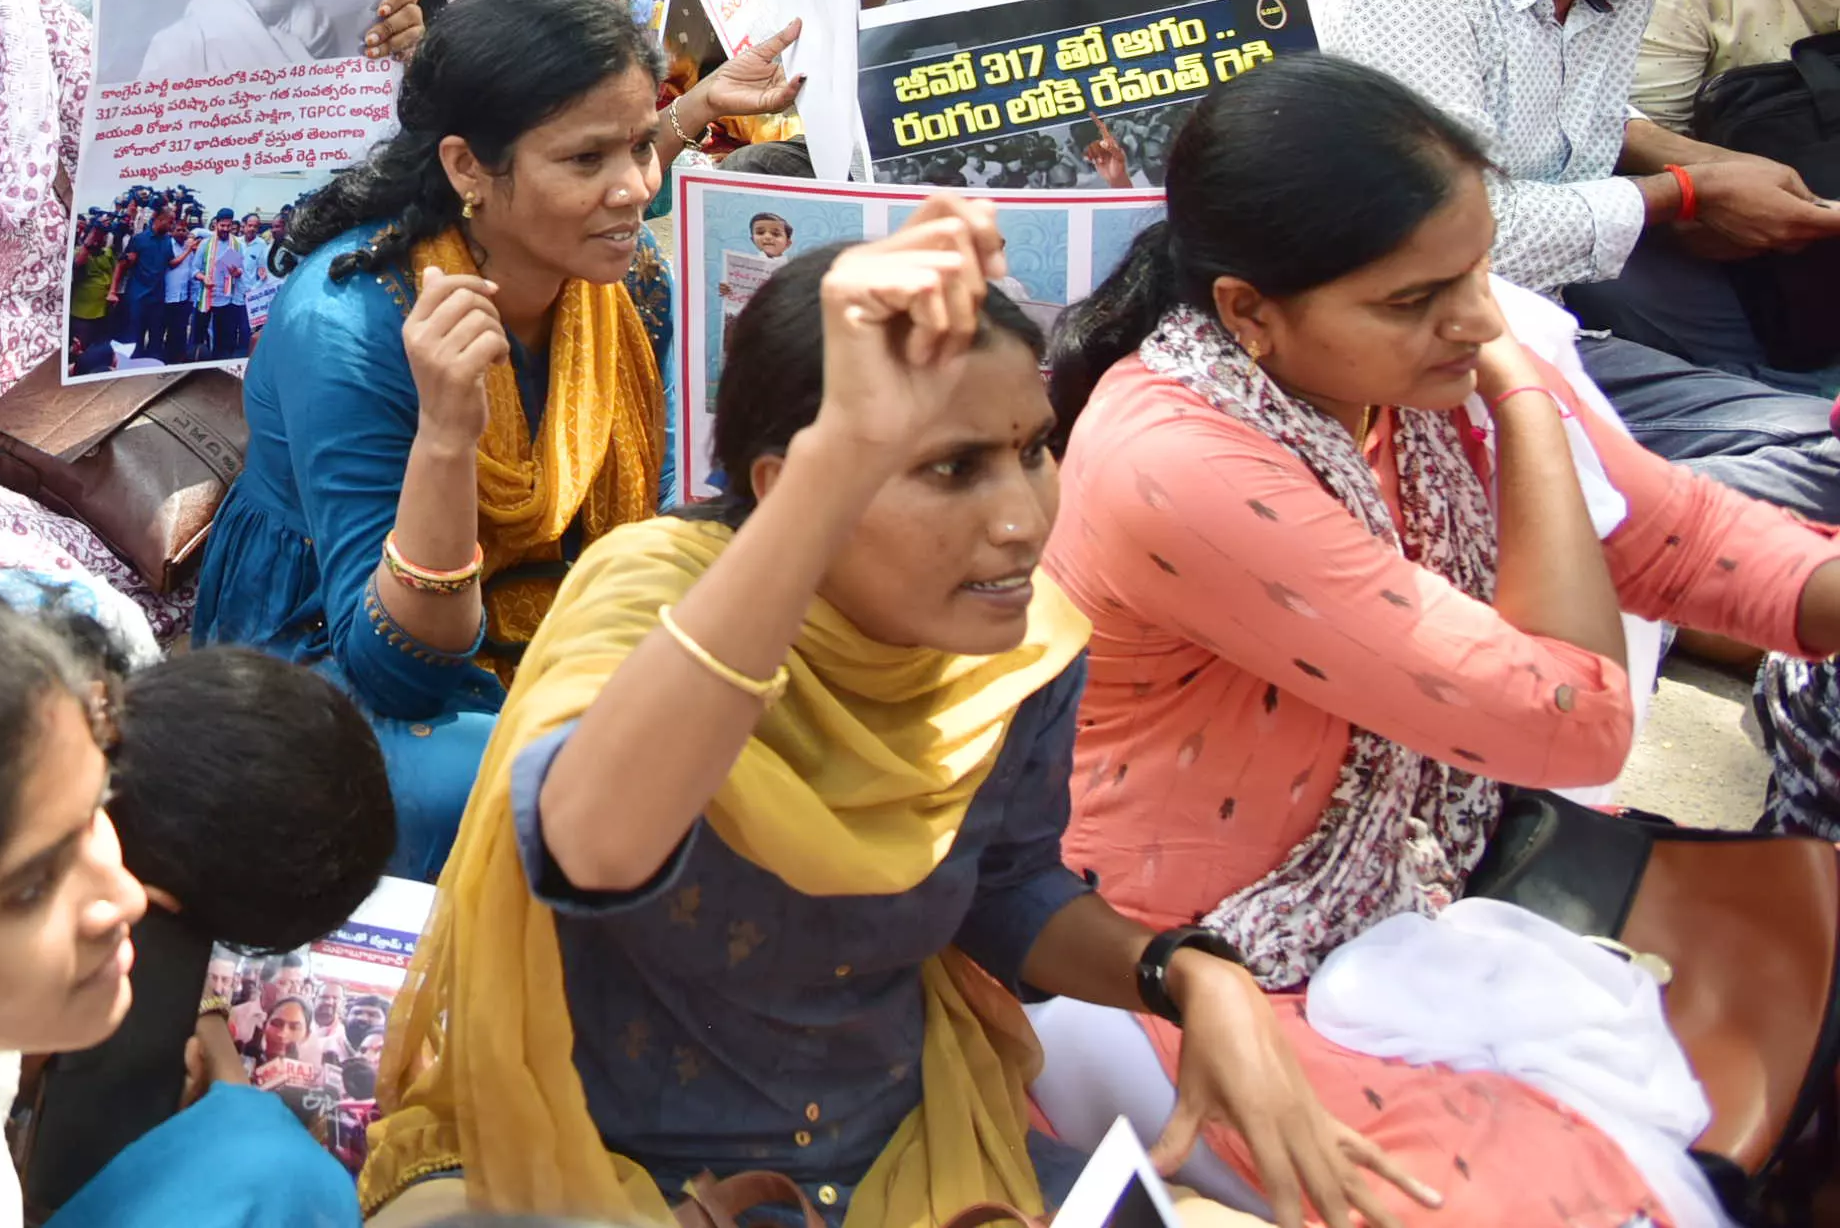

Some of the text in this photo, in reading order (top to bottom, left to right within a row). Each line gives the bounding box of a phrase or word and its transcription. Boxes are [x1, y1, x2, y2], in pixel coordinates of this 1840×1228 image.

[144, 80, 170, 100] పార్టీ
[172, 72, 246, 94] అధికారంలోకి
[250, 68, 287, 86] వచ్చిన
[290, 65, 306, 78] 48
[366, 59, 390, 73] G.O
[892, 15, 1207, 104] జీవో 317 తో ఆగం
[96, 107, 118, 120] 317
[120, 102, 164, 119] సమస్య
[270, 88, 290, 102] గత
[292, 85, 356, 104] సంవత్సరం
[359, 79, 392, 96] గాంధీ
[299, 105, 347, 120] TGPCC
[350, 104, 391, 122] అధ్యక్ష
[892, 52, 1210, 147] రంగం లోకి రేవంత్
[168, 140, 192, 152] 317
[266, 130, 304, 147] ప్రస్తుత
[307, 128, 365, 141] తెలంగాణ
[242, 152, 252, 170] శ్రీ
[254, 148, 294, 165] రేవంత్
[296, 148, 318, 168] రెడ్డి
